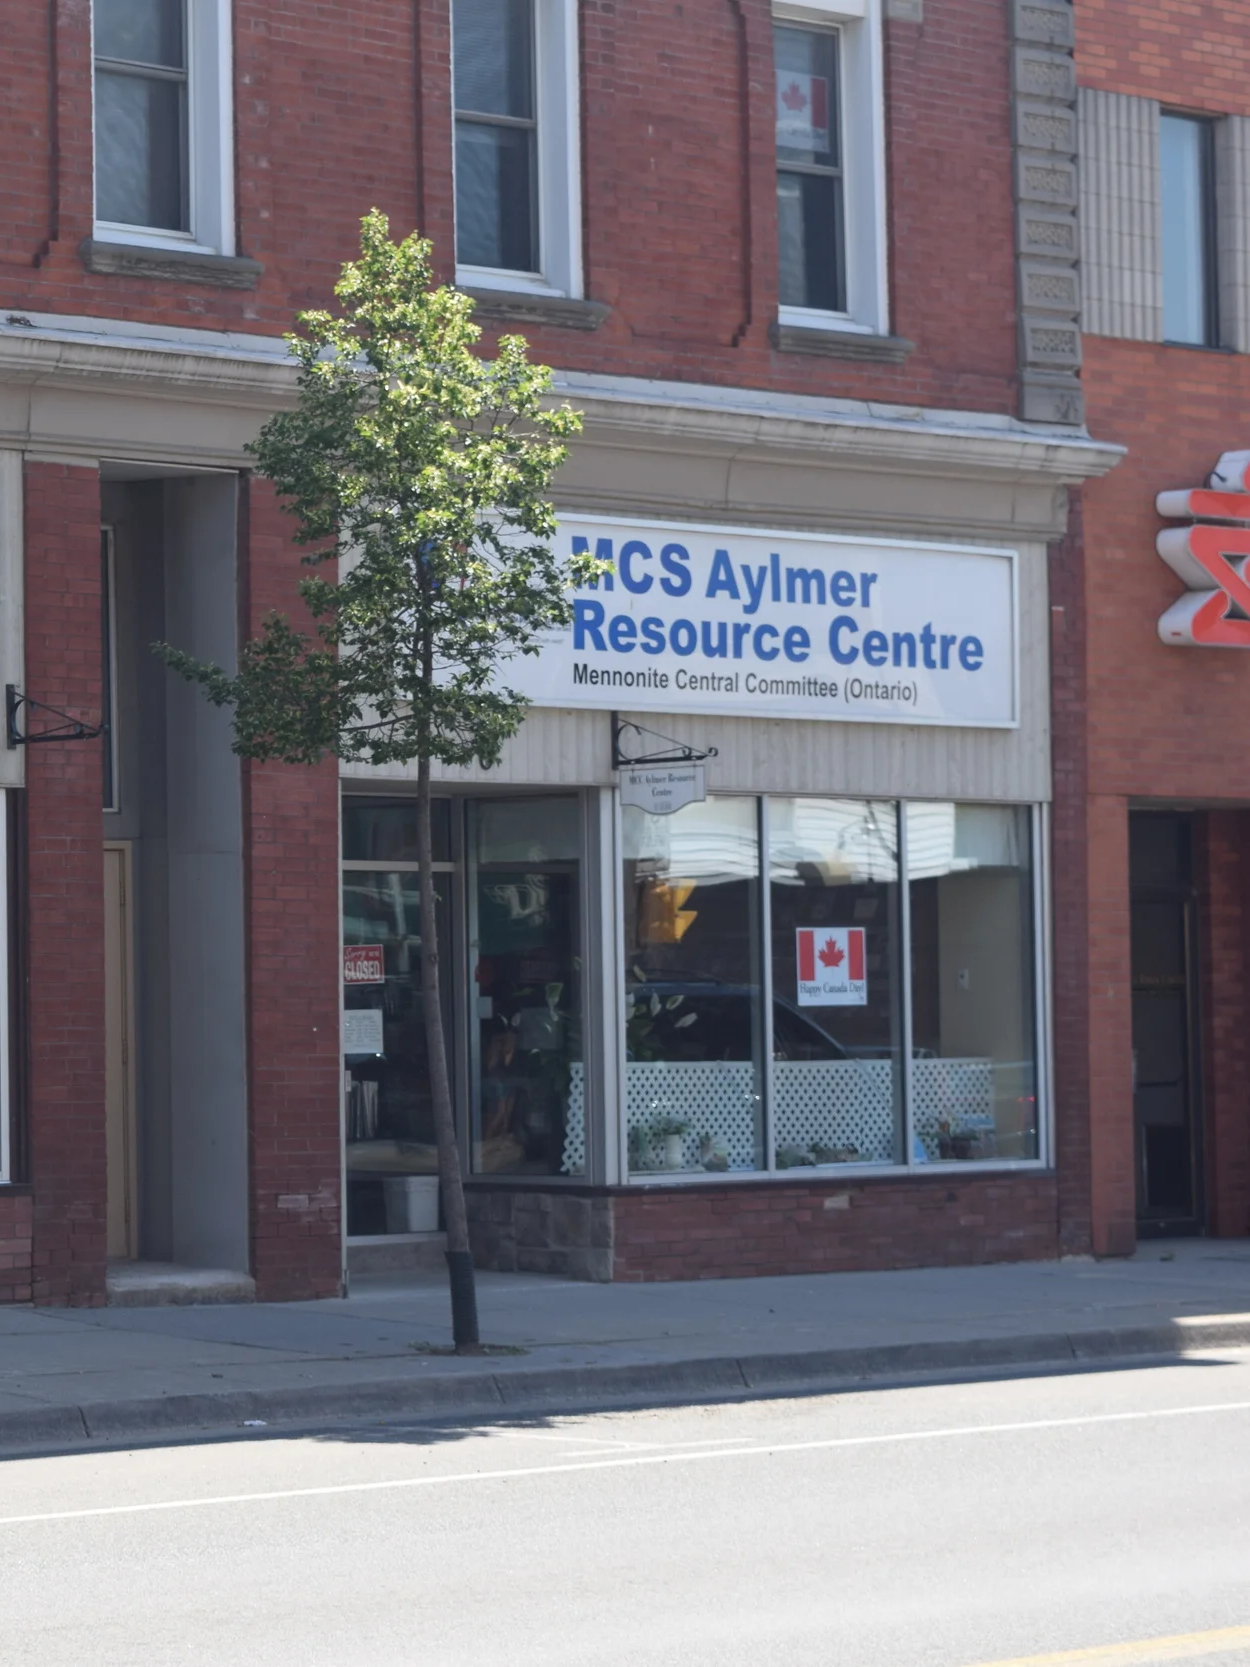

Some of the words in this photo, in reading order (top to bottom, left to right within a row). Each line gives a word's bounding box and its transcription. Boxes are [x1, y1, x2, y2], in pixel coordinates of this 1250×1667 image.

[571, 536, 692, 597] MCS
[705, 549, 878, 614] Aylmer
[573, 598, 811, 662] Resource
[829, 615, 984, 672] Centre
[573, 663, 669, 689] Mennonite
[676, 669, 739, 693] Central
[745, 673, 839, 698] Committee
[844, 678, 918, 702] (Ontario)
[345, 961, 380, 980] CLOSED
[822, 981, 847, 993] Canada
